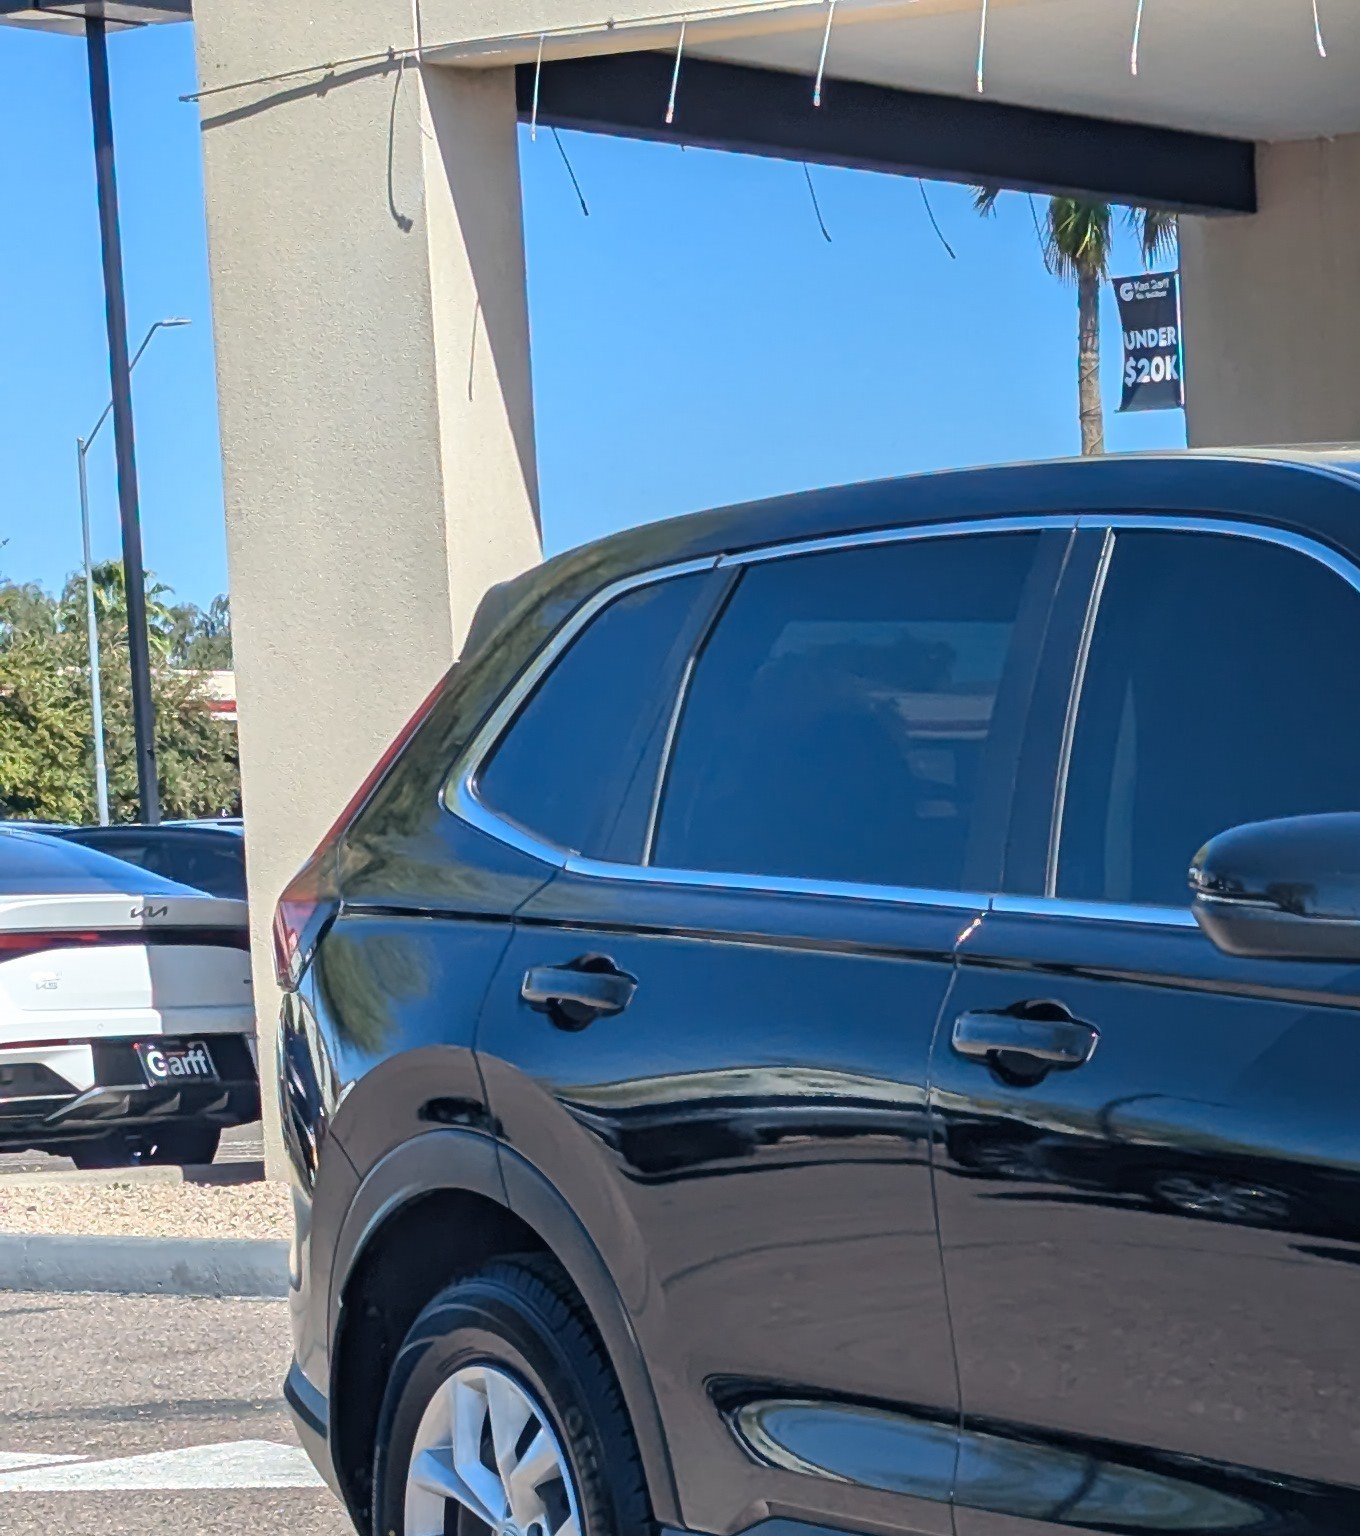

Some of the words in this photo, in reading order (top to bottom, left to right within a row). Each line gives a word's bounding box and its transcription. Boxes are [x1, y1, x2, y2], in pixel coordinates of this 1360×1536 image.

[1124, 326, 1177, 351] UNDER
[1124, 354, 1179, 387] $20K
[147, 1049, 209, 1077] Garff
